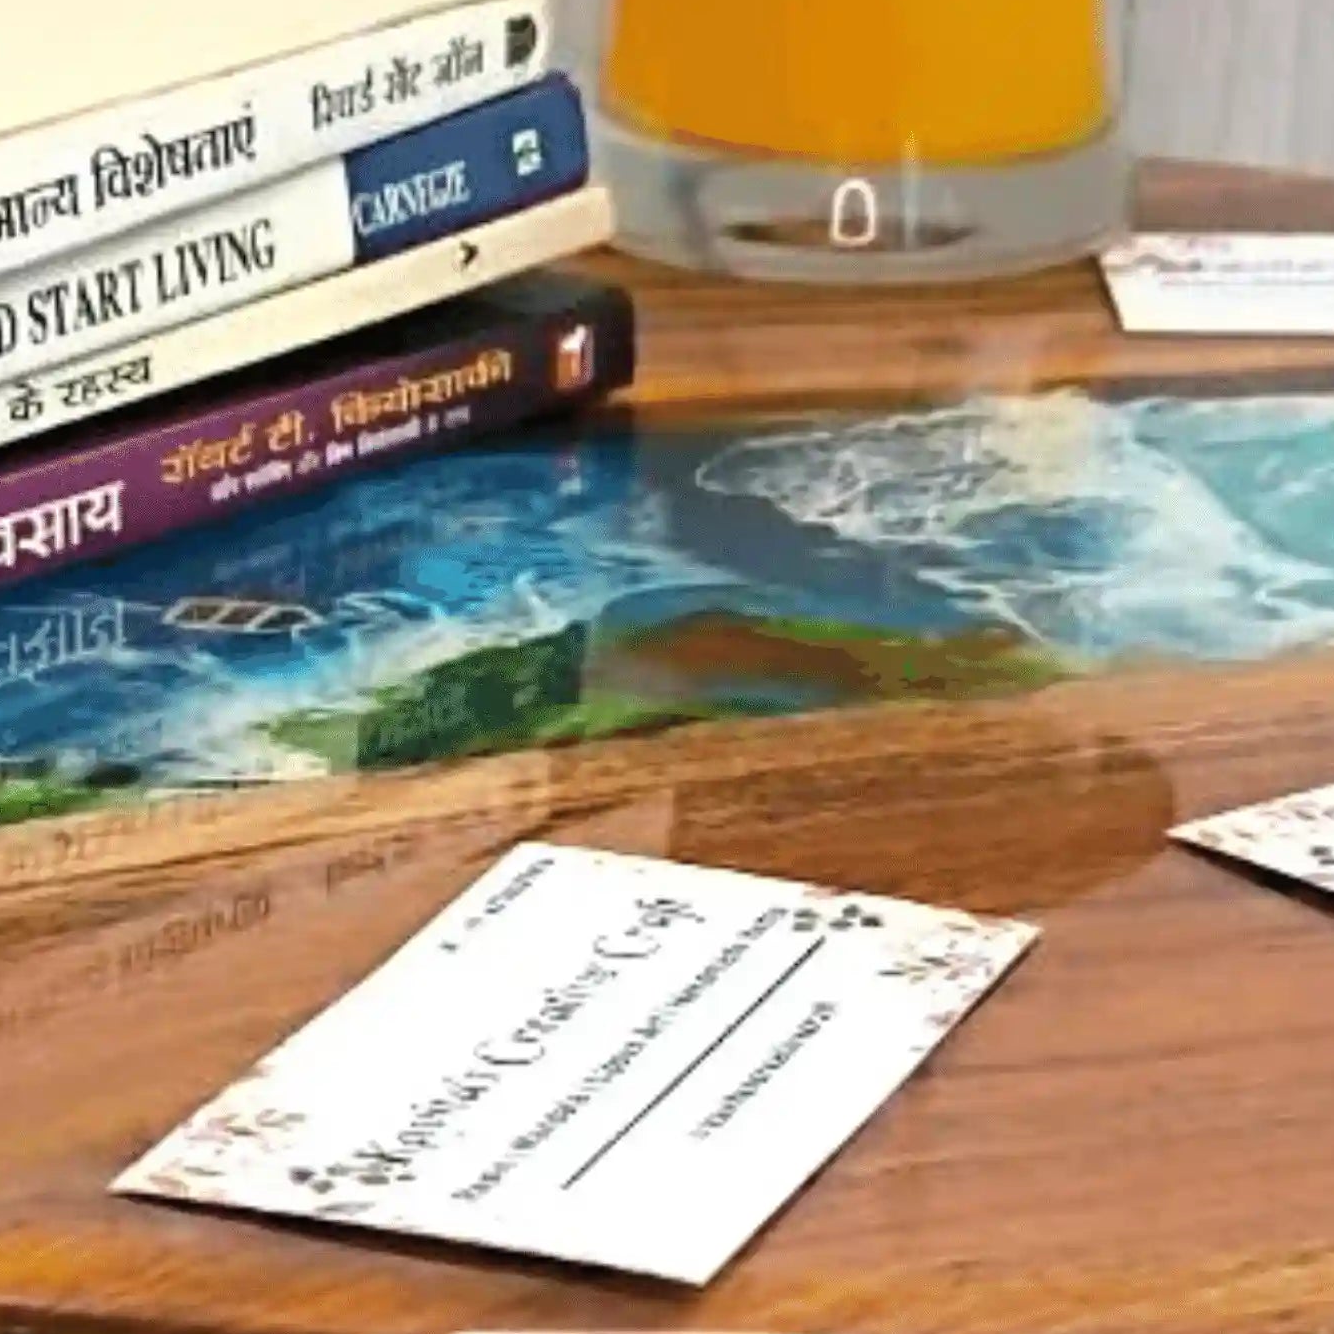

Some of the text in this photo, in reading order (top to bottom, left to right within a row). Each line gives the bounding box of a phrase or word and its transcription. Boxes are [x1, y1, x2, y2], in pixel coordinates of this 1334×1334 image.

[28, 256, 143, 347] START
[153, 217, 278, 307] LIVING
[8, 379, 47, 424] के
[57, 354, 153, 409] रहस्य
